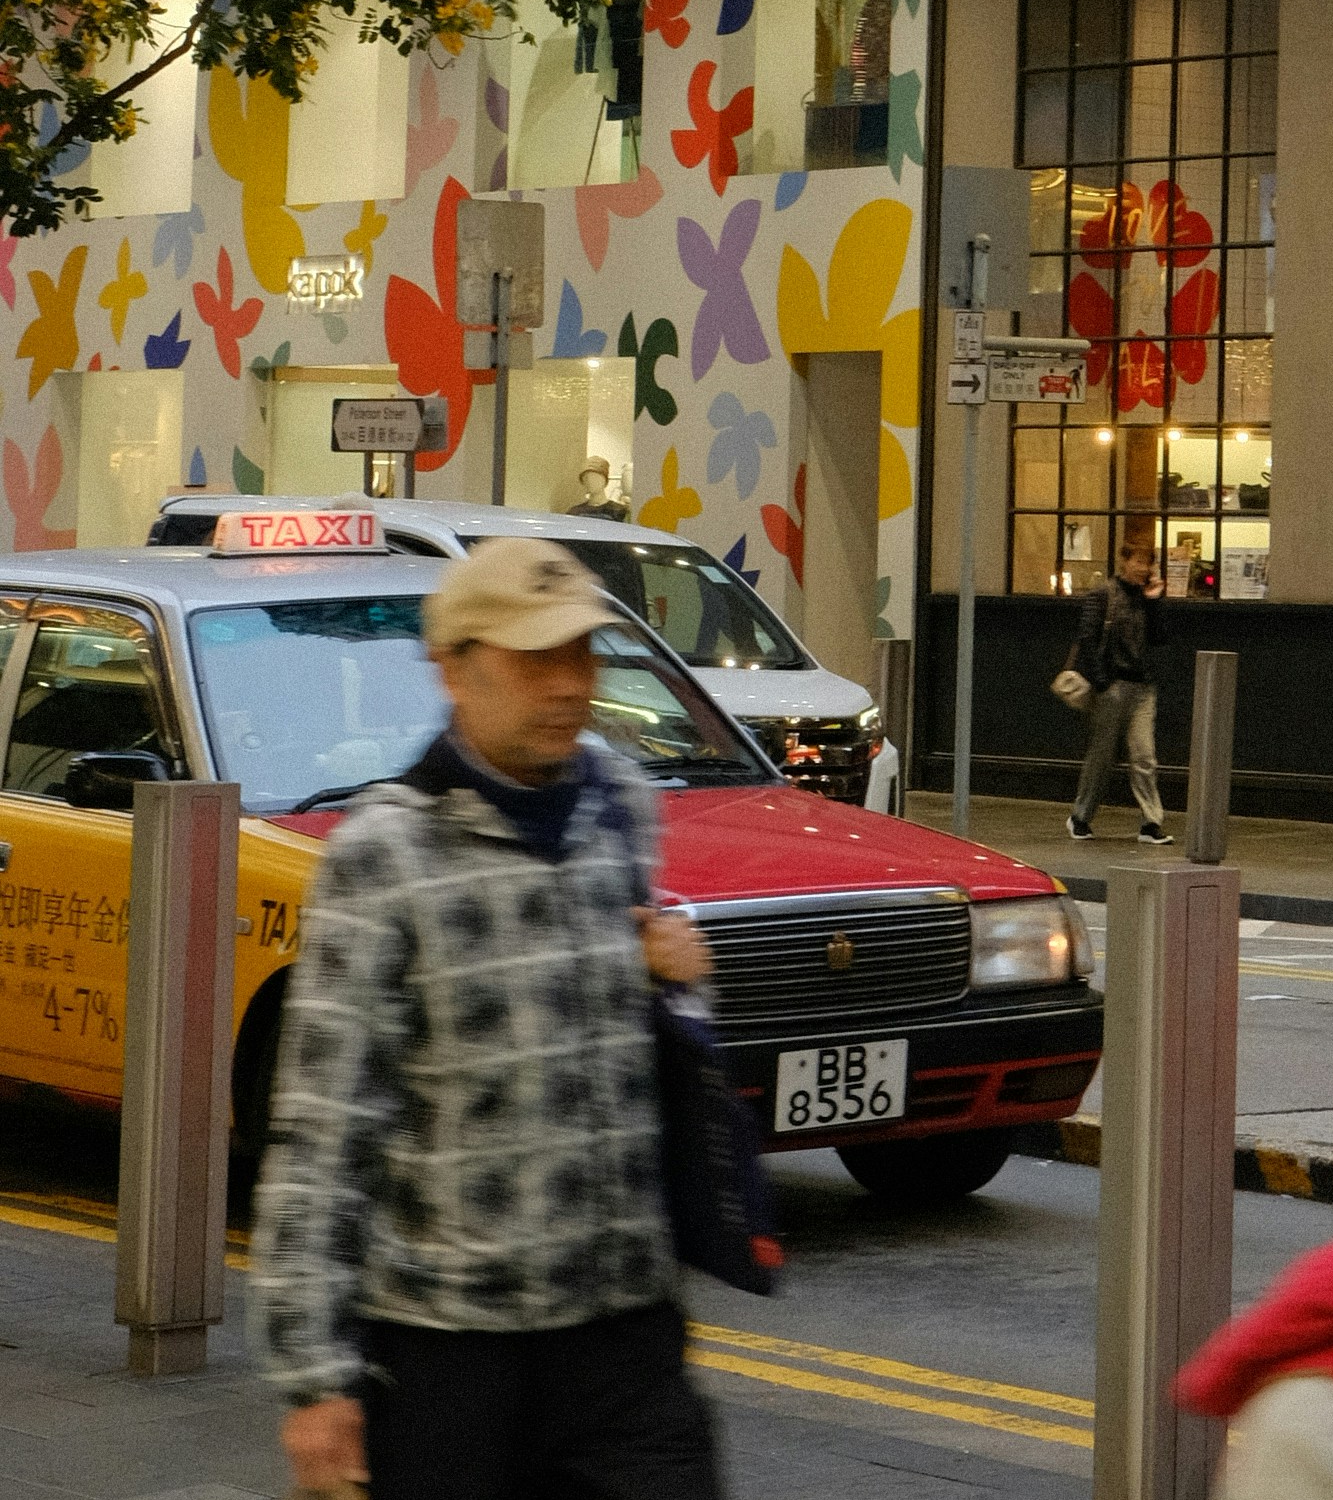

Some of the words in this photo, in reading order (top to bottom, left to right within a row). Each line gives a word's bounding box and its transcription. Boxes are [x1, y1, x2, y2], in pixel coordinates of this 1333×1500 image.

[240, 514, 374, 547] TAXI
[44, 985, 119, 1042] 4-7%
[817, 1045, 866, 1087] BB
[788, 1079, 892, 1126] 8556
